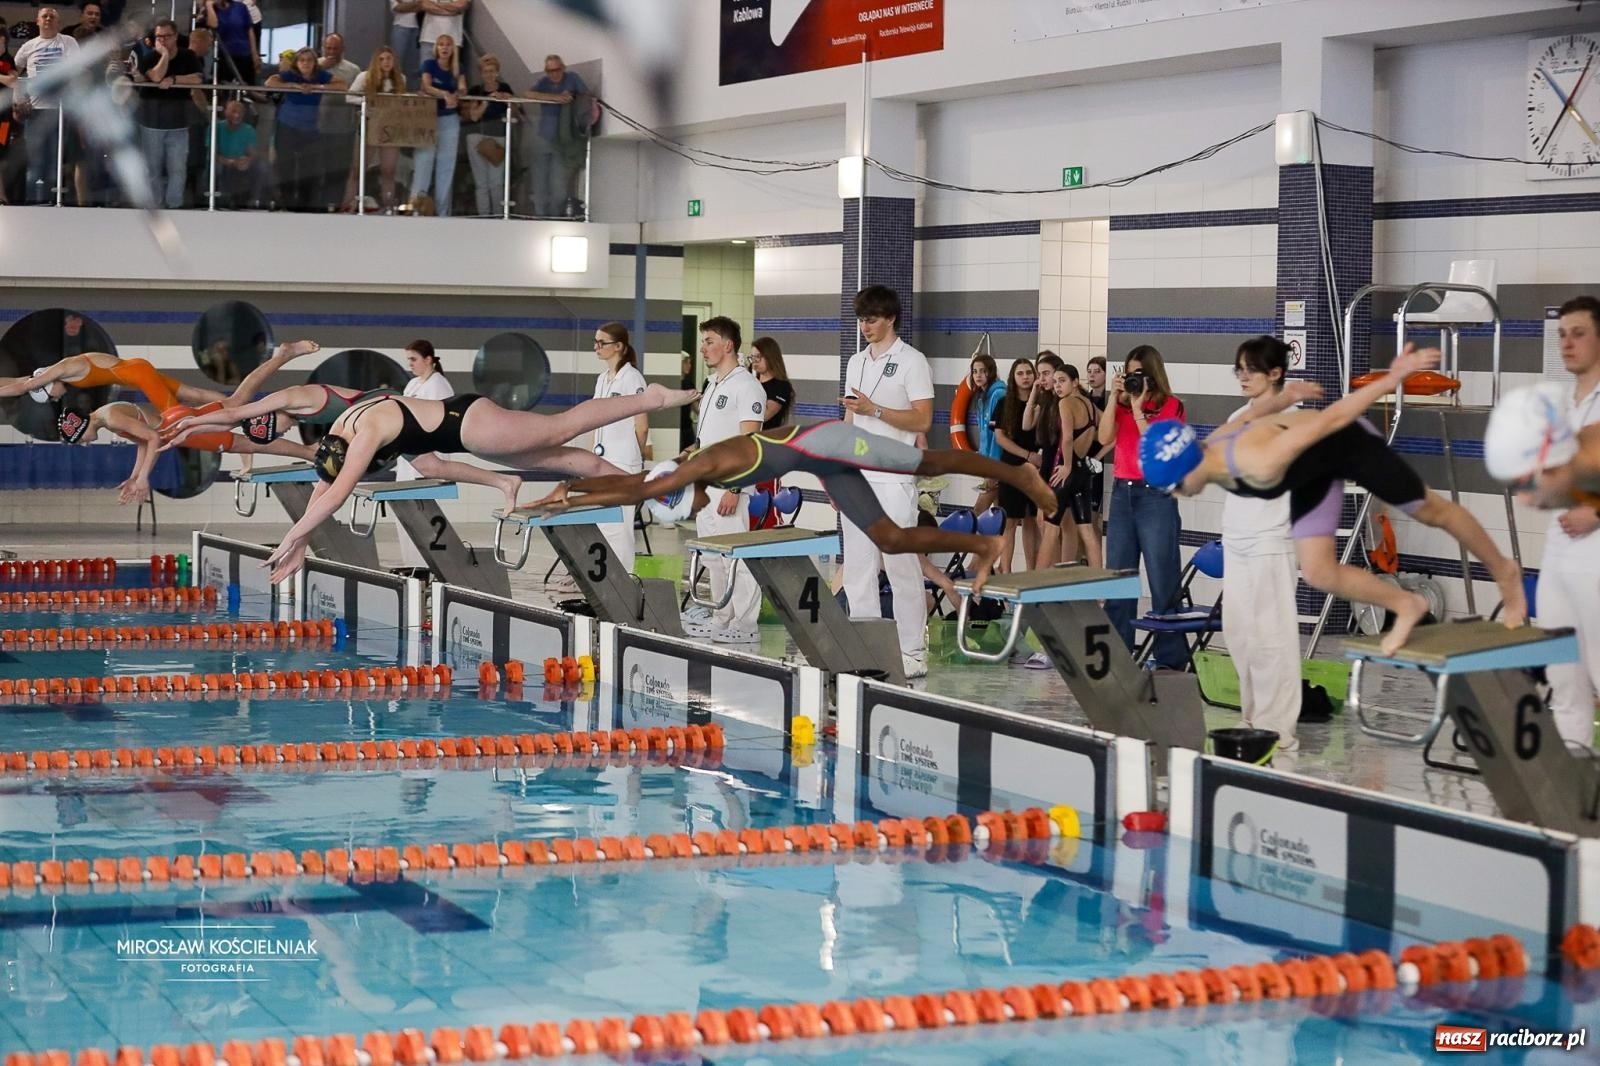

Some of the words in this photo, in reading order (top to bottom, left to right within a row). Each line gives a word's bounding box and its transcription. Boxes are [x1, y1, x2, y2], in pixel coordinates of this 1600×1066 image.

[733, 6, 763, 23] Kablowa
[858, 10, 883, 22] OGLĄDAJ
[883, 7, 894, 17] NAS
[895, 5, 901, 15] W
[901, 0, 934, 14] INTERNECIE
[430, 515, 447, 551] 2
[588, 542, 607, 582] 3
[798, 576, 820, 623] 4
[1084, 624, 1111, 680] 5
[645, 674, 670, 689] Colorado
[1515, 694, 1542, 761] 6
[900, 738, 934, 759] Colorado
[1260, 828, 1310, 855] Colorado
